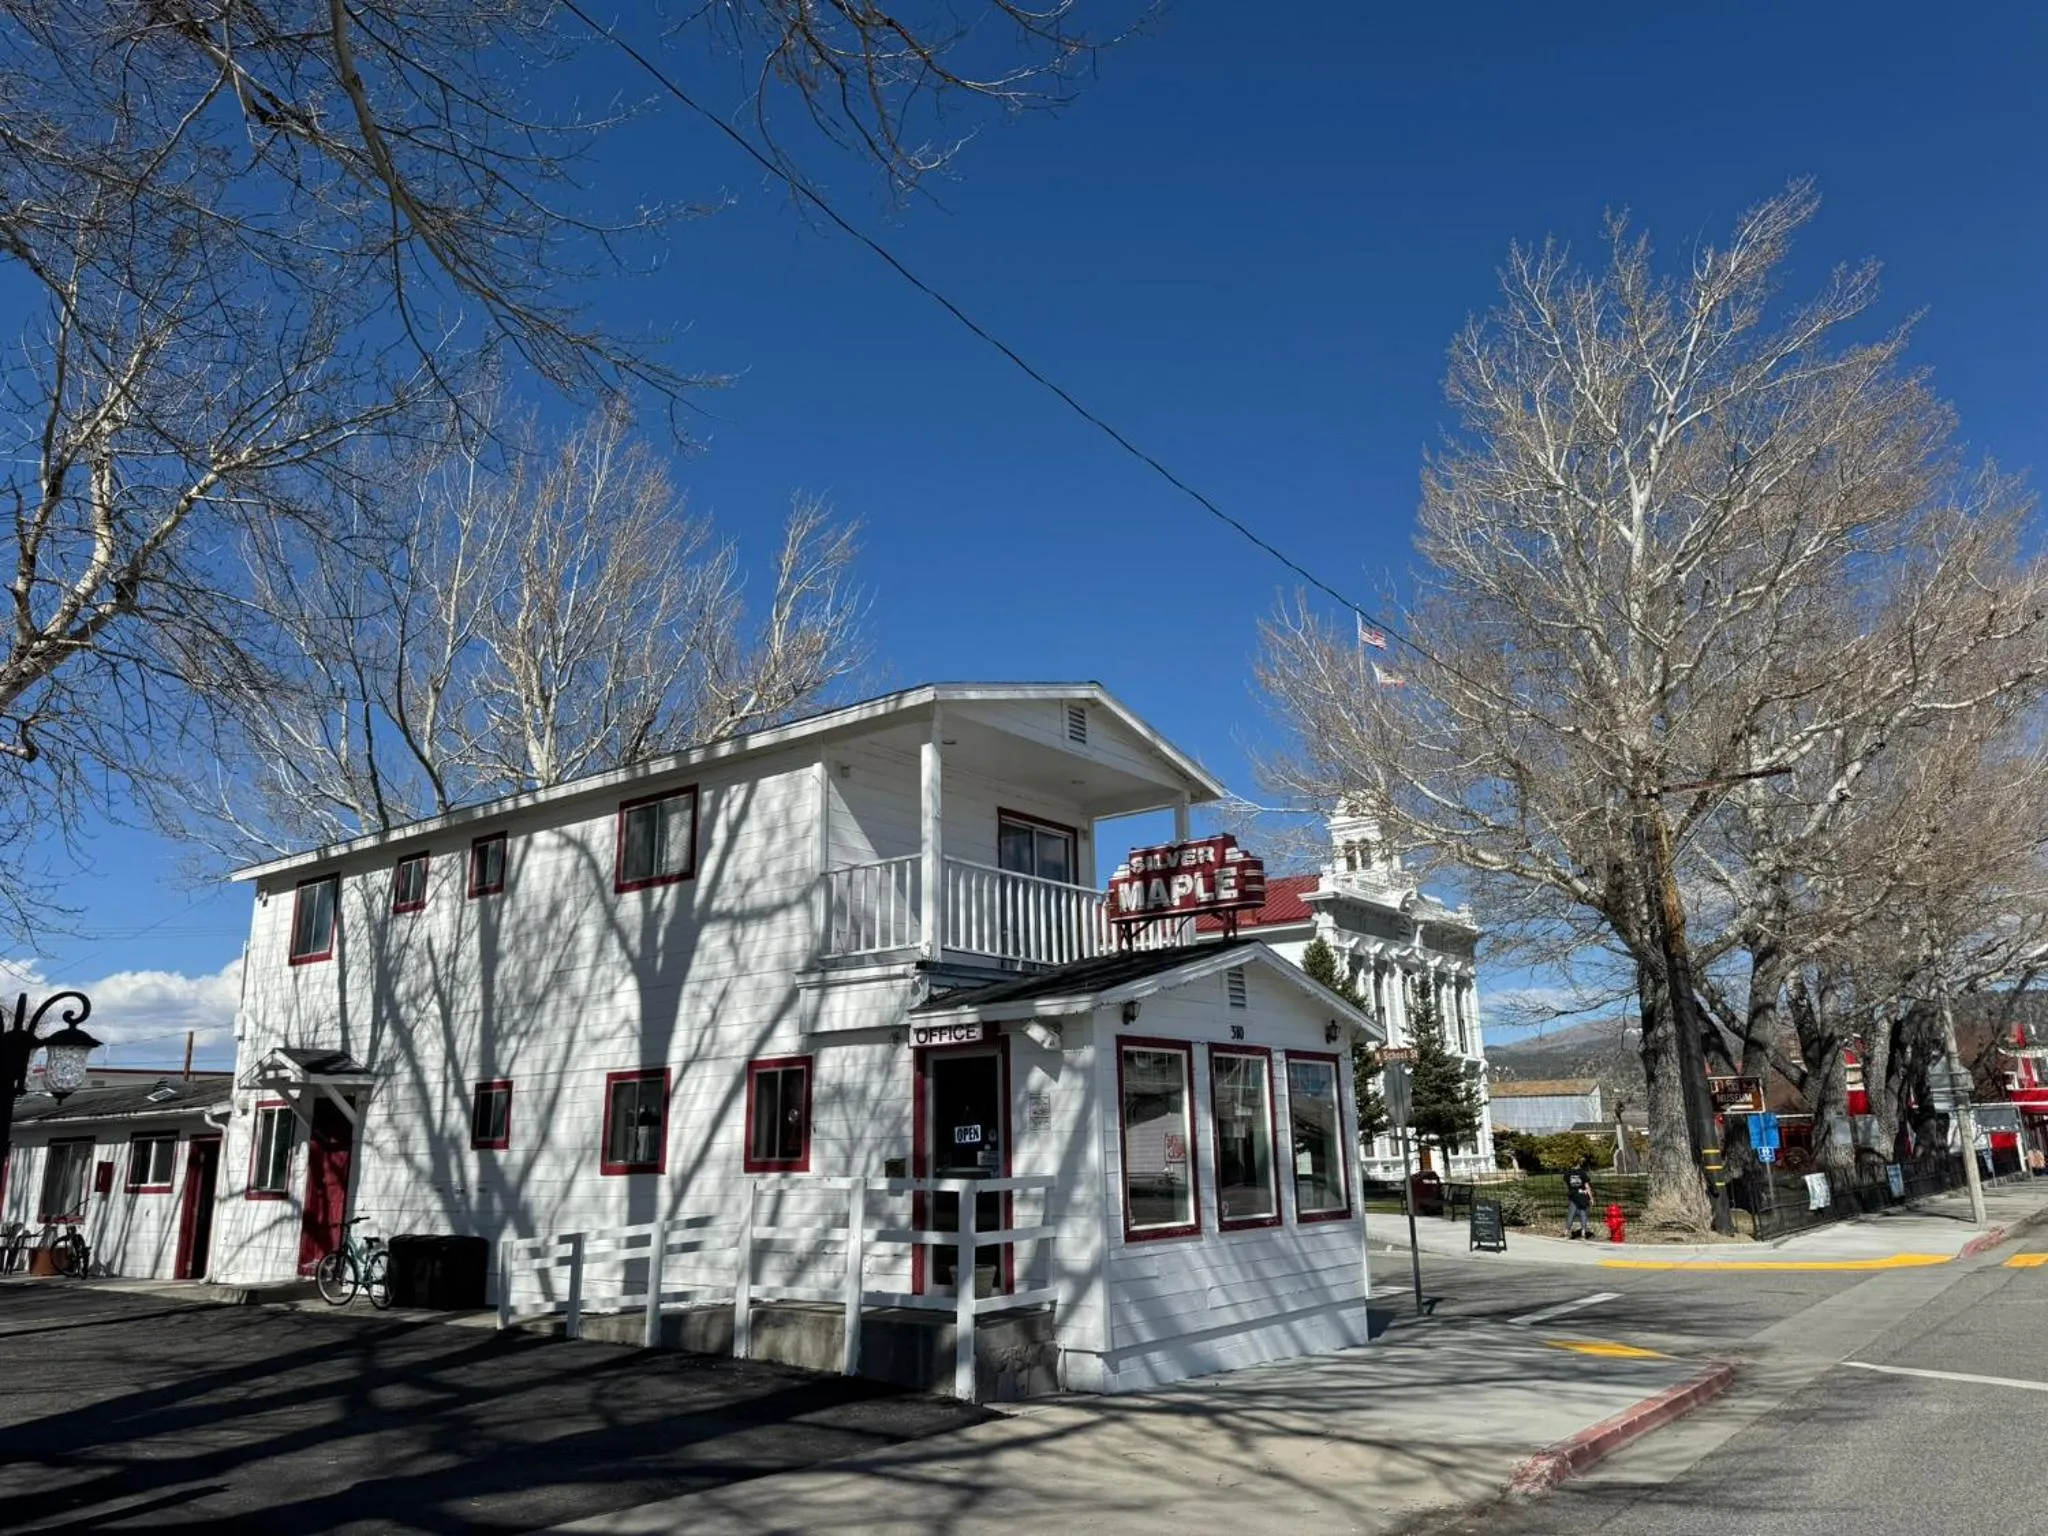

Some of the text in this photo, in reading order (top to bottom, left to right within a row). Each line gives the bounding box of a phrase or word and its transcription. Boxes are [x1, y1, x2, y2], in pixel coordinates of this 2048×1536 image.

[1130, 845, 1215, 873] SILVER
[1117, 867, 1239, 912] MAPLE
[915, 1024, 976, 1044] OFFICE
[956, 1127, 980, 1142] OPEN
